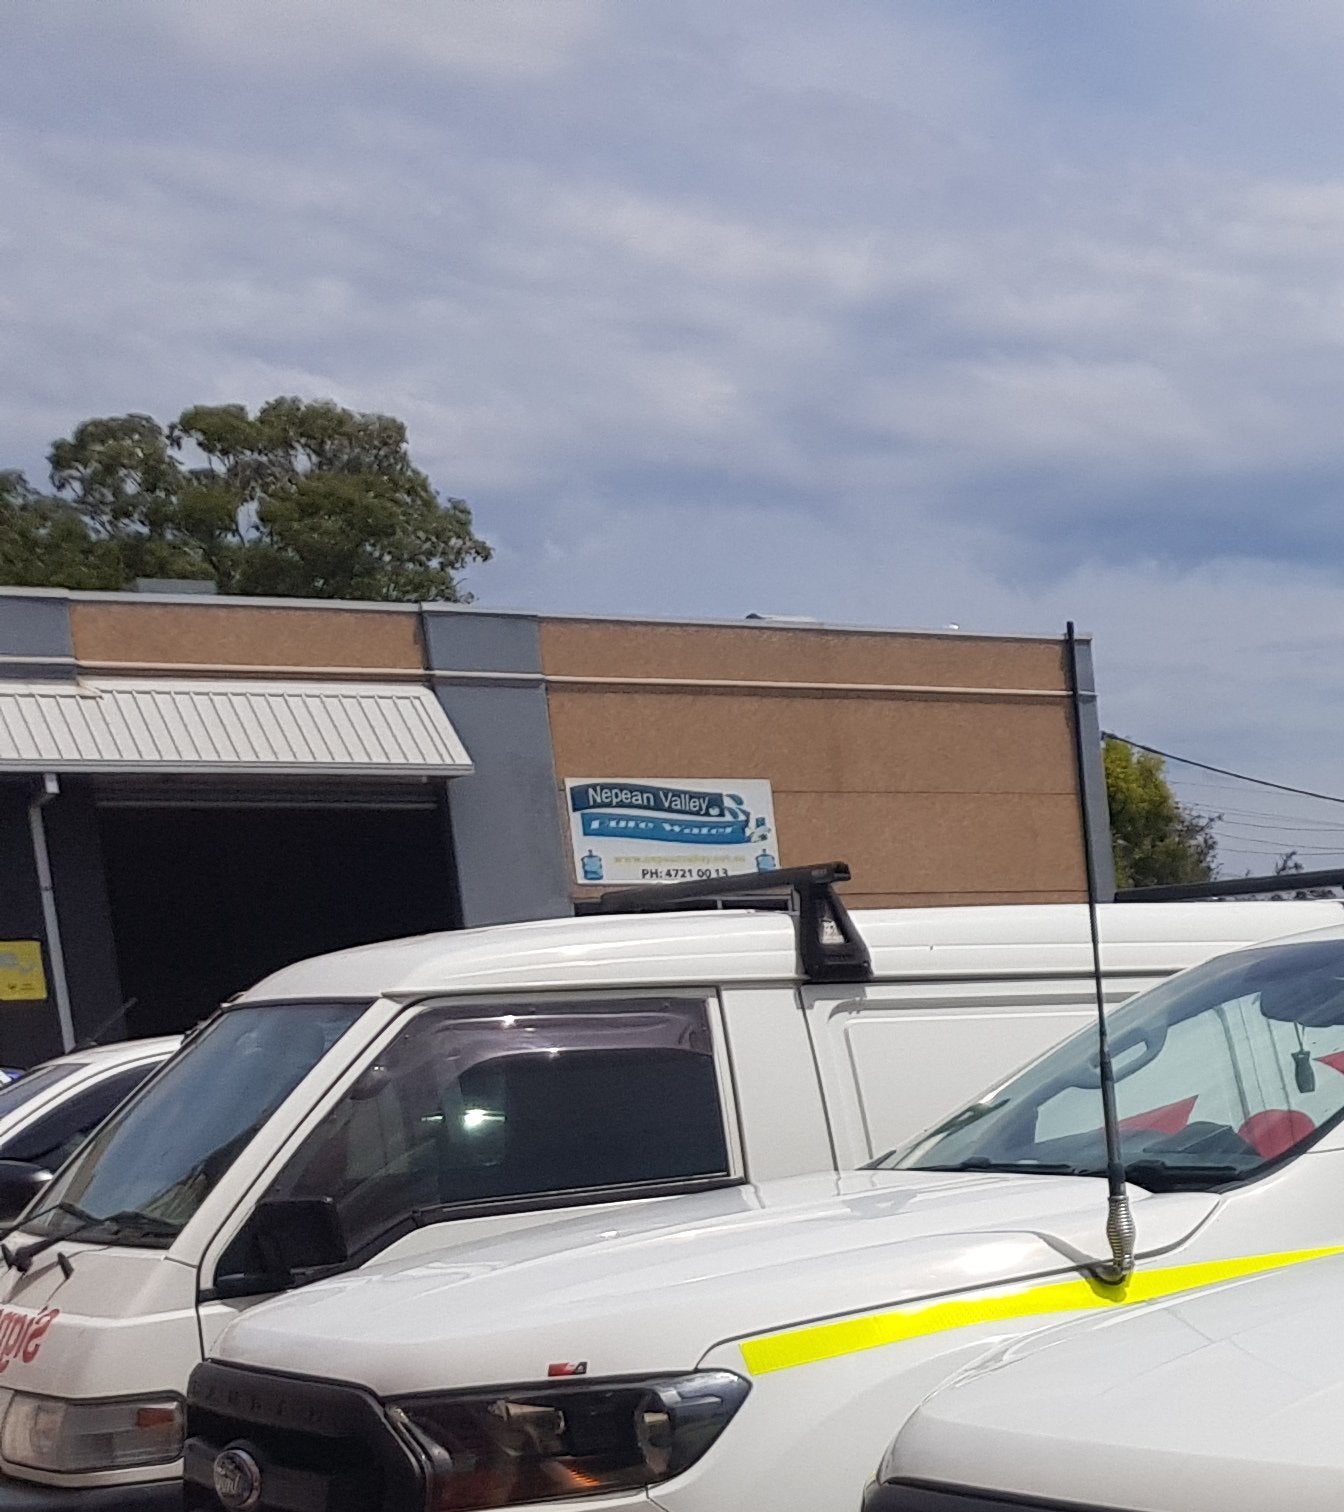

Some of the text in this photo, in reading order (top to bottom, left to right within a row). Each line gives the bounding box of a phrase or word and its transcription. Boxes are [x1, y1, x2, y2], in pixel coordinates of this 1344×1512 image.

[588, 785, 710, 815] Nepean Valley
[641, 868, 663, 879] PH:
[665, 868, 694, 879] 4721
